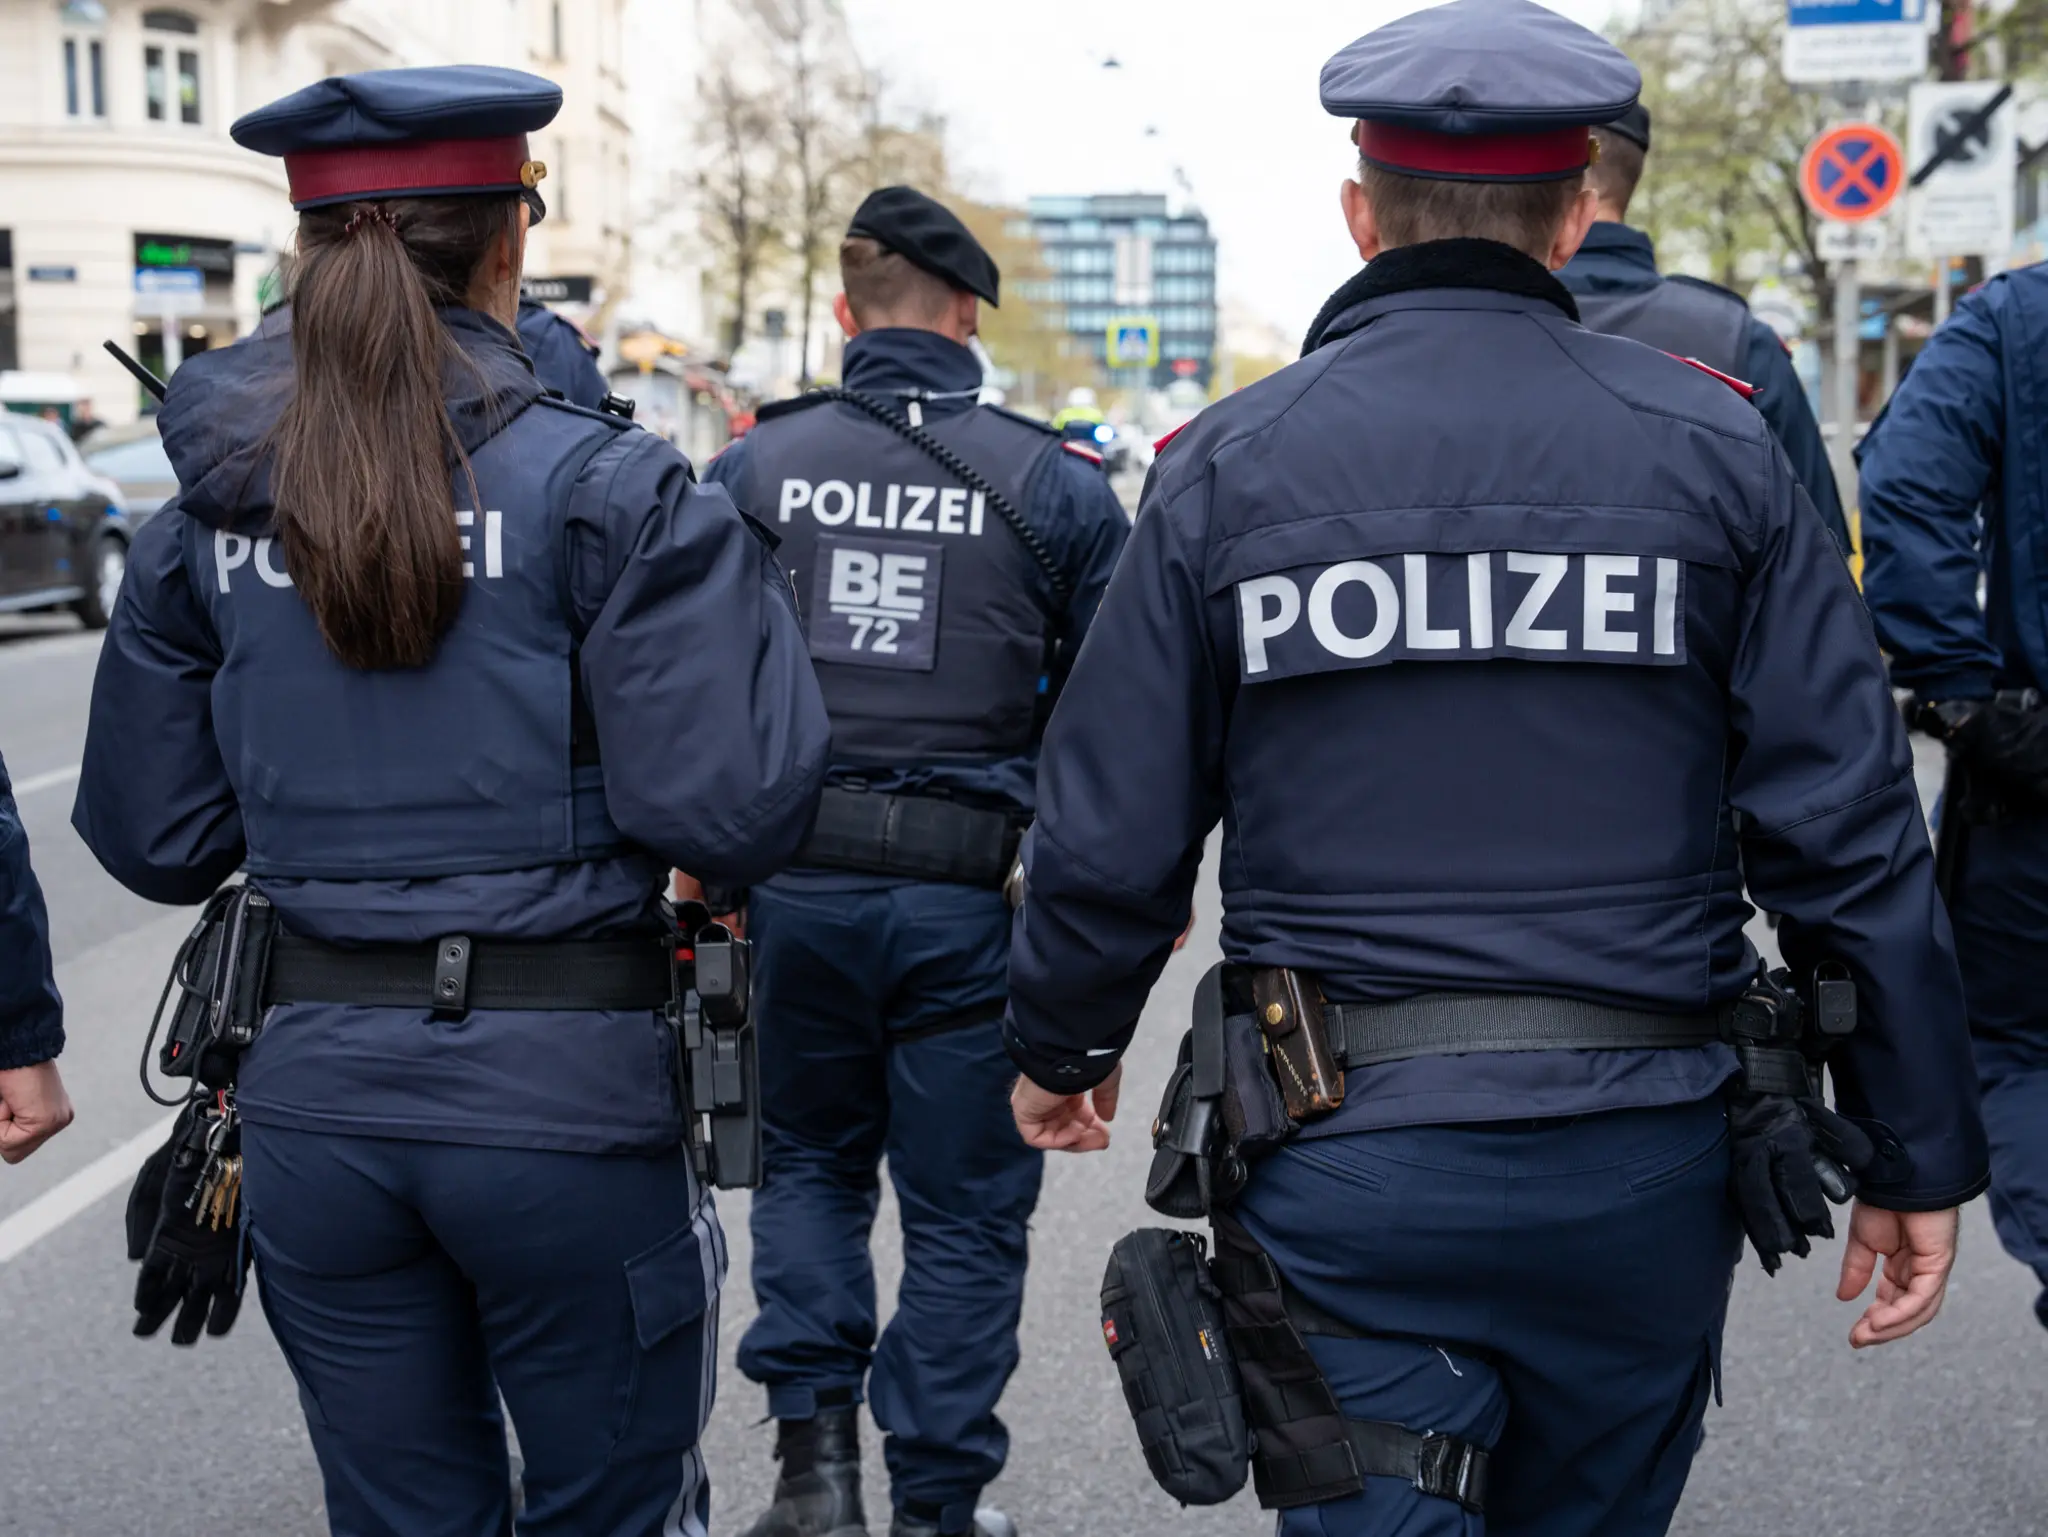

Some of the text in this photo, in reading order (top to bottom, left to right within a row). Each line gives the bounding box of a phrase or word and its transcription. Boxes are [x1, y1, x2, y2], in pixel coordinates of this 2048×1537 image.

[778, 478, 986, 536] POLIZEI
[828, 548, 927, 612] BE
[848, 615, 900, 654] 72
[1239, 551, 1678, 674] POLIZEI
